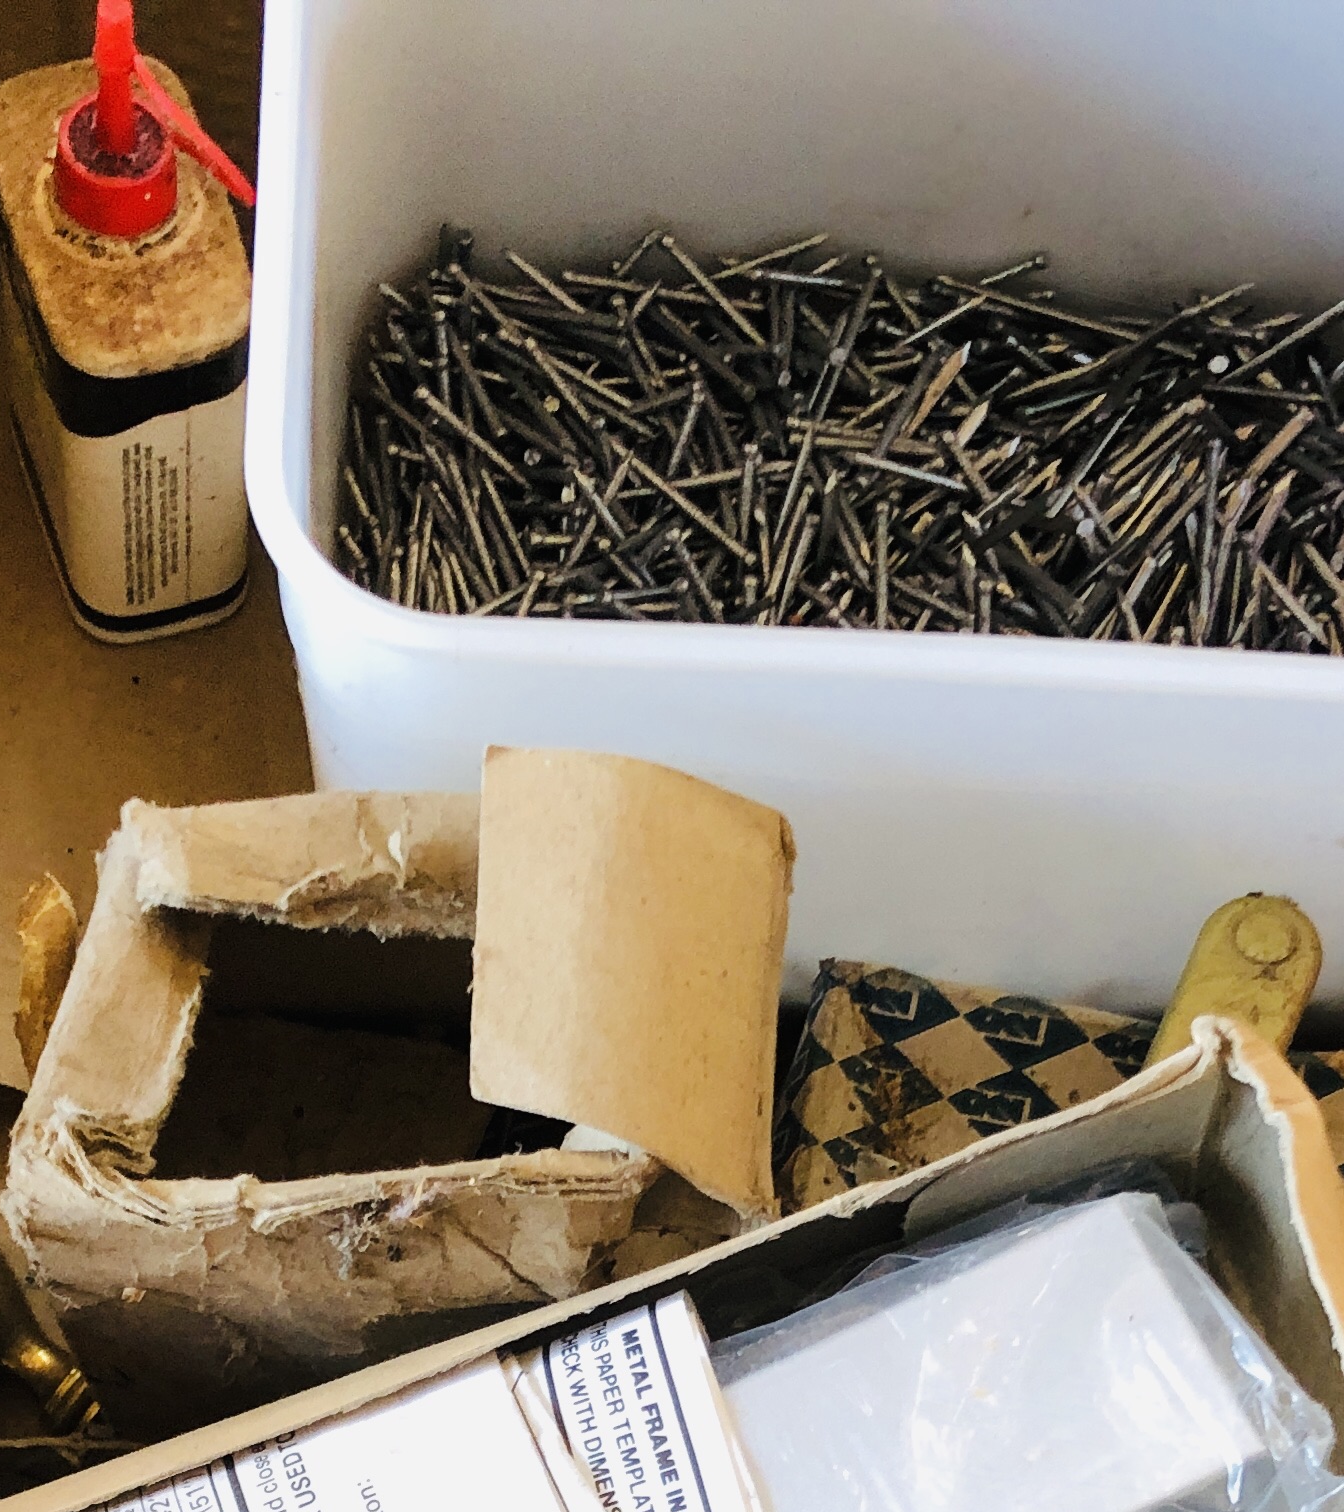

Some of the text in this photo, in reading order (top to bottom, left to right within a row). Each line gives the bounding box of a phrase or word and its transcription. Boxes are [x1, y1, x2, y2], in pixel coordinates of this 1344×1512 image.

[569, 1377, 599, 1434] WITH
[596, 1352, 626, 1416] PAPER
[621, 1328, 653, 1400] METAL
[641, 1402, 680, 1486] FRAME
[244, 1448, 278, 1493] close
[281, 1451, 316, 1508] USED
